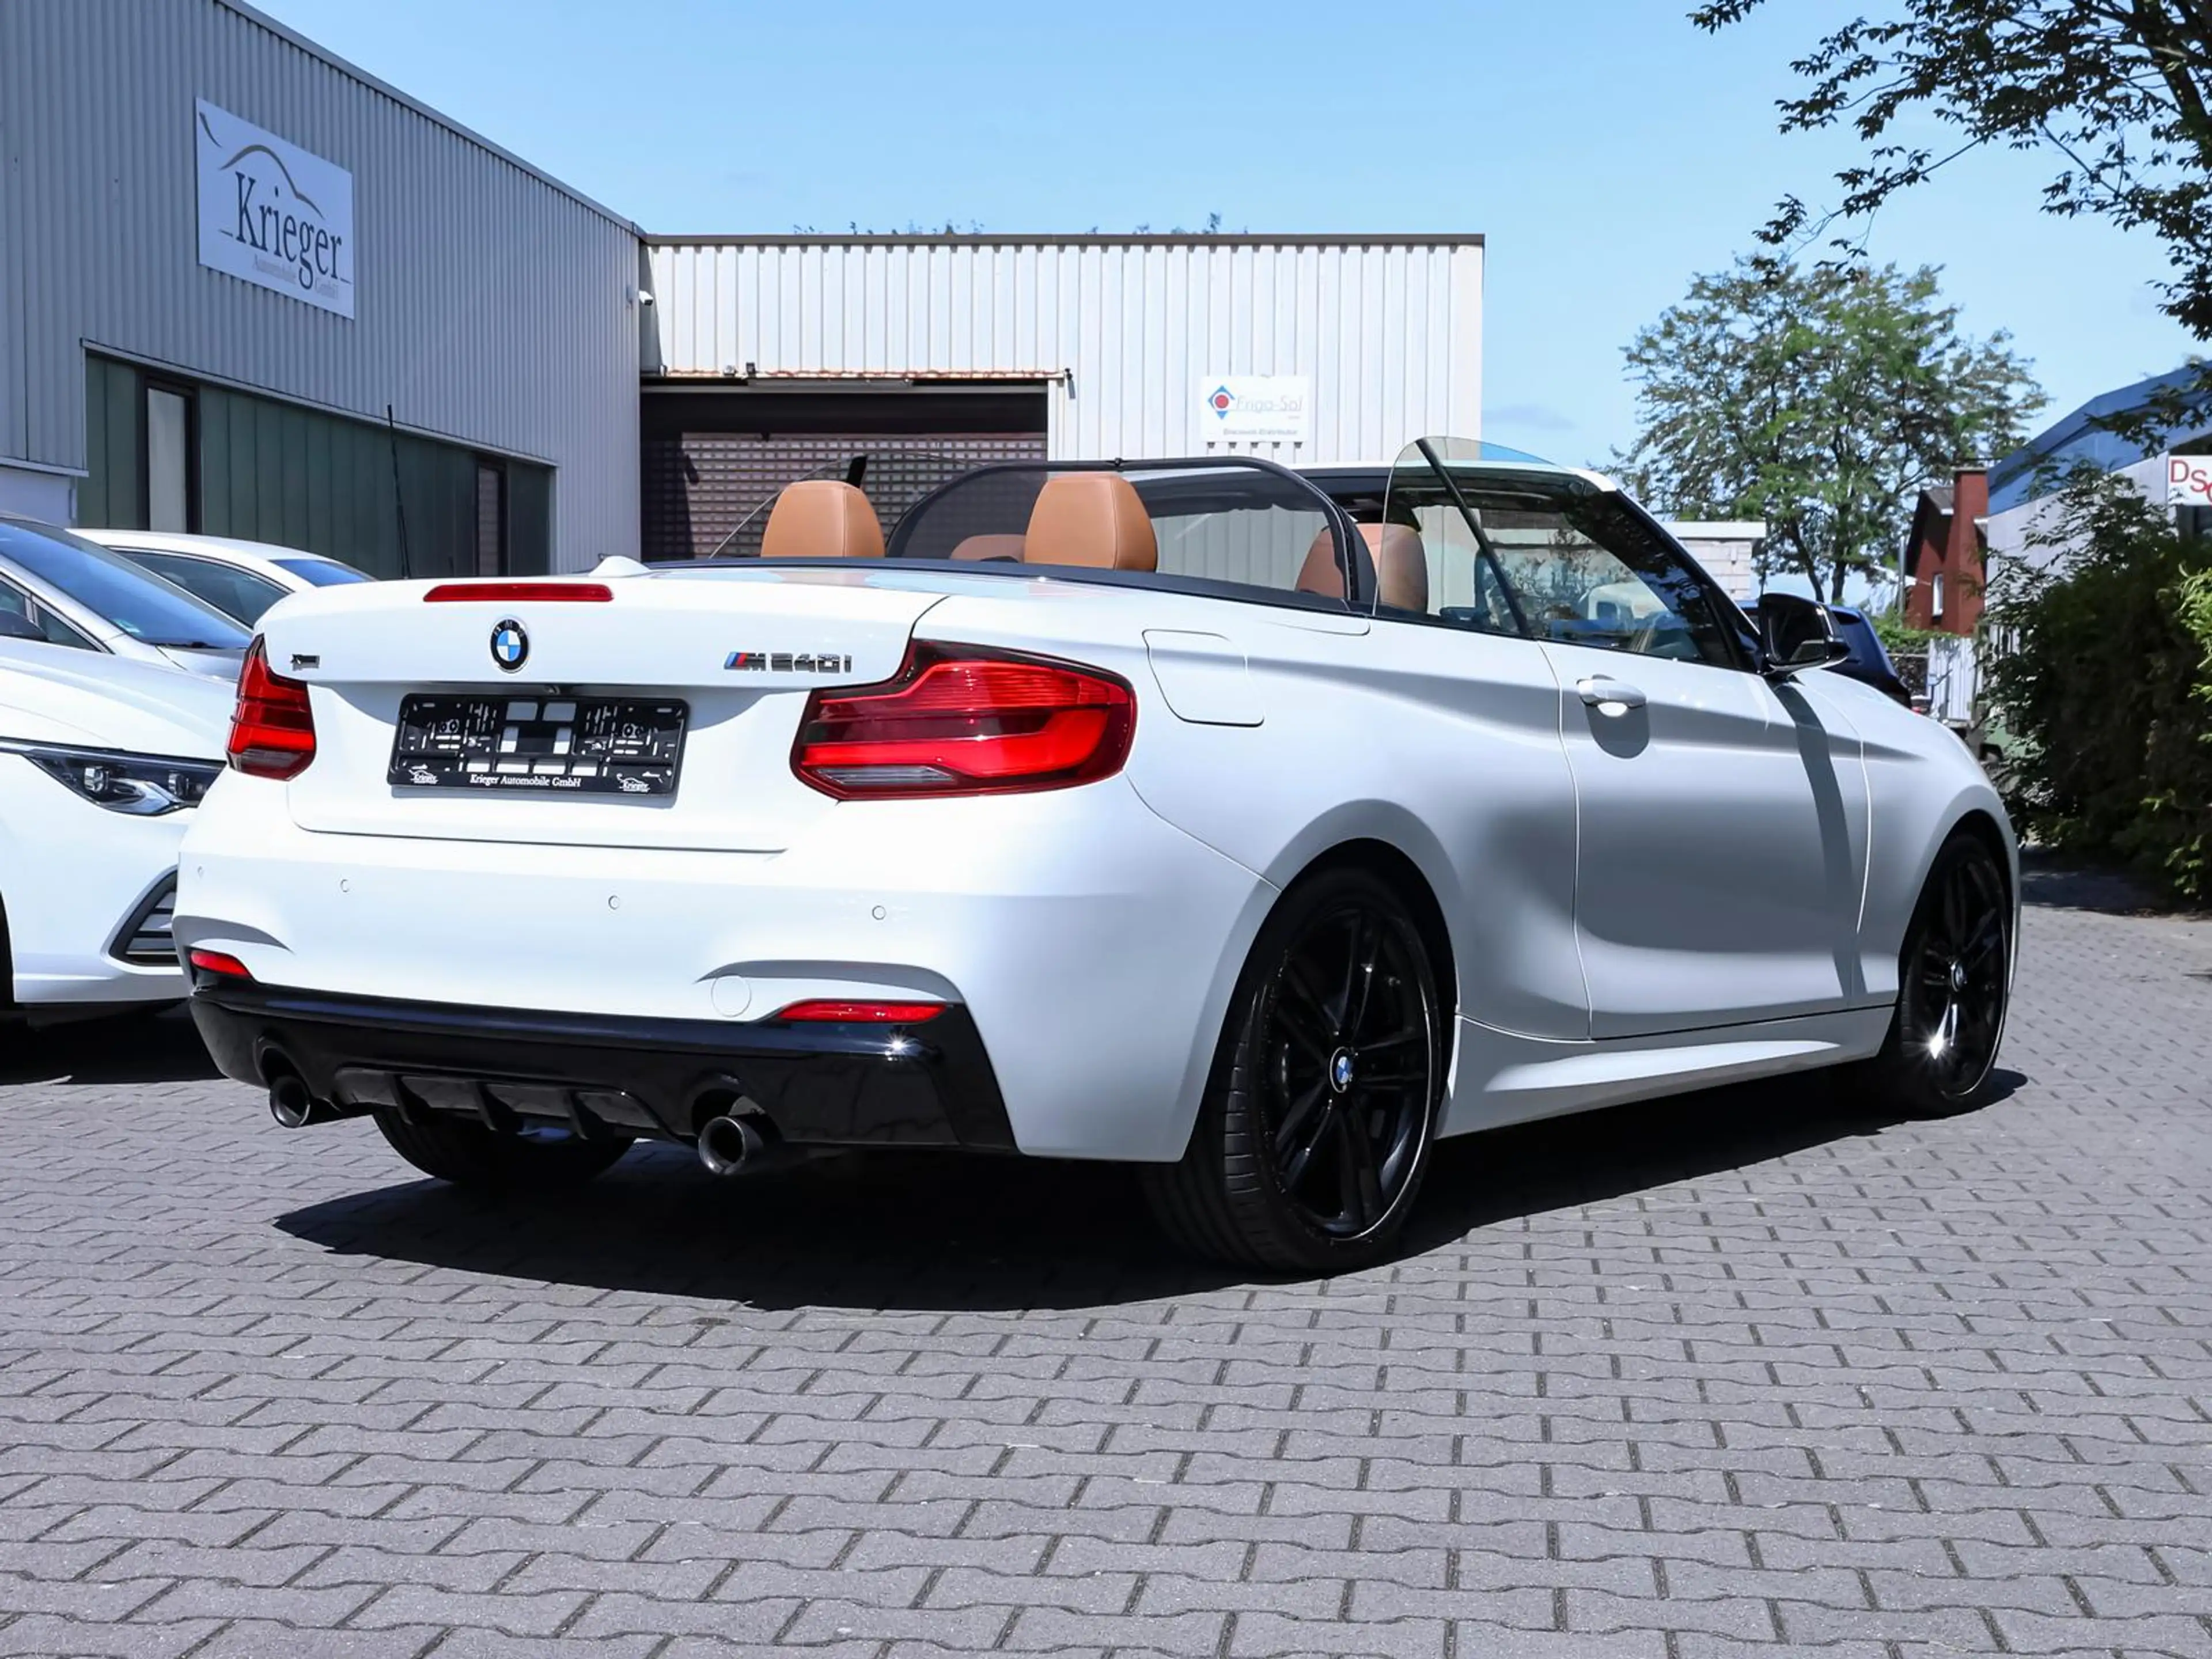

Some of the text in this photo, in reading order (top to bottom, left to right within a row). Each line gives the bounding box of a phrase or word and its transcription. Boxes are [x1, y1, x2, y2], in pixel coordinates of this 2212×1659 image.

[235, 171, 342, 289] Krieger
[737, 652, 852, 673] M240i
[470, 774, 582, 787] Krieger Automobile GmbH
